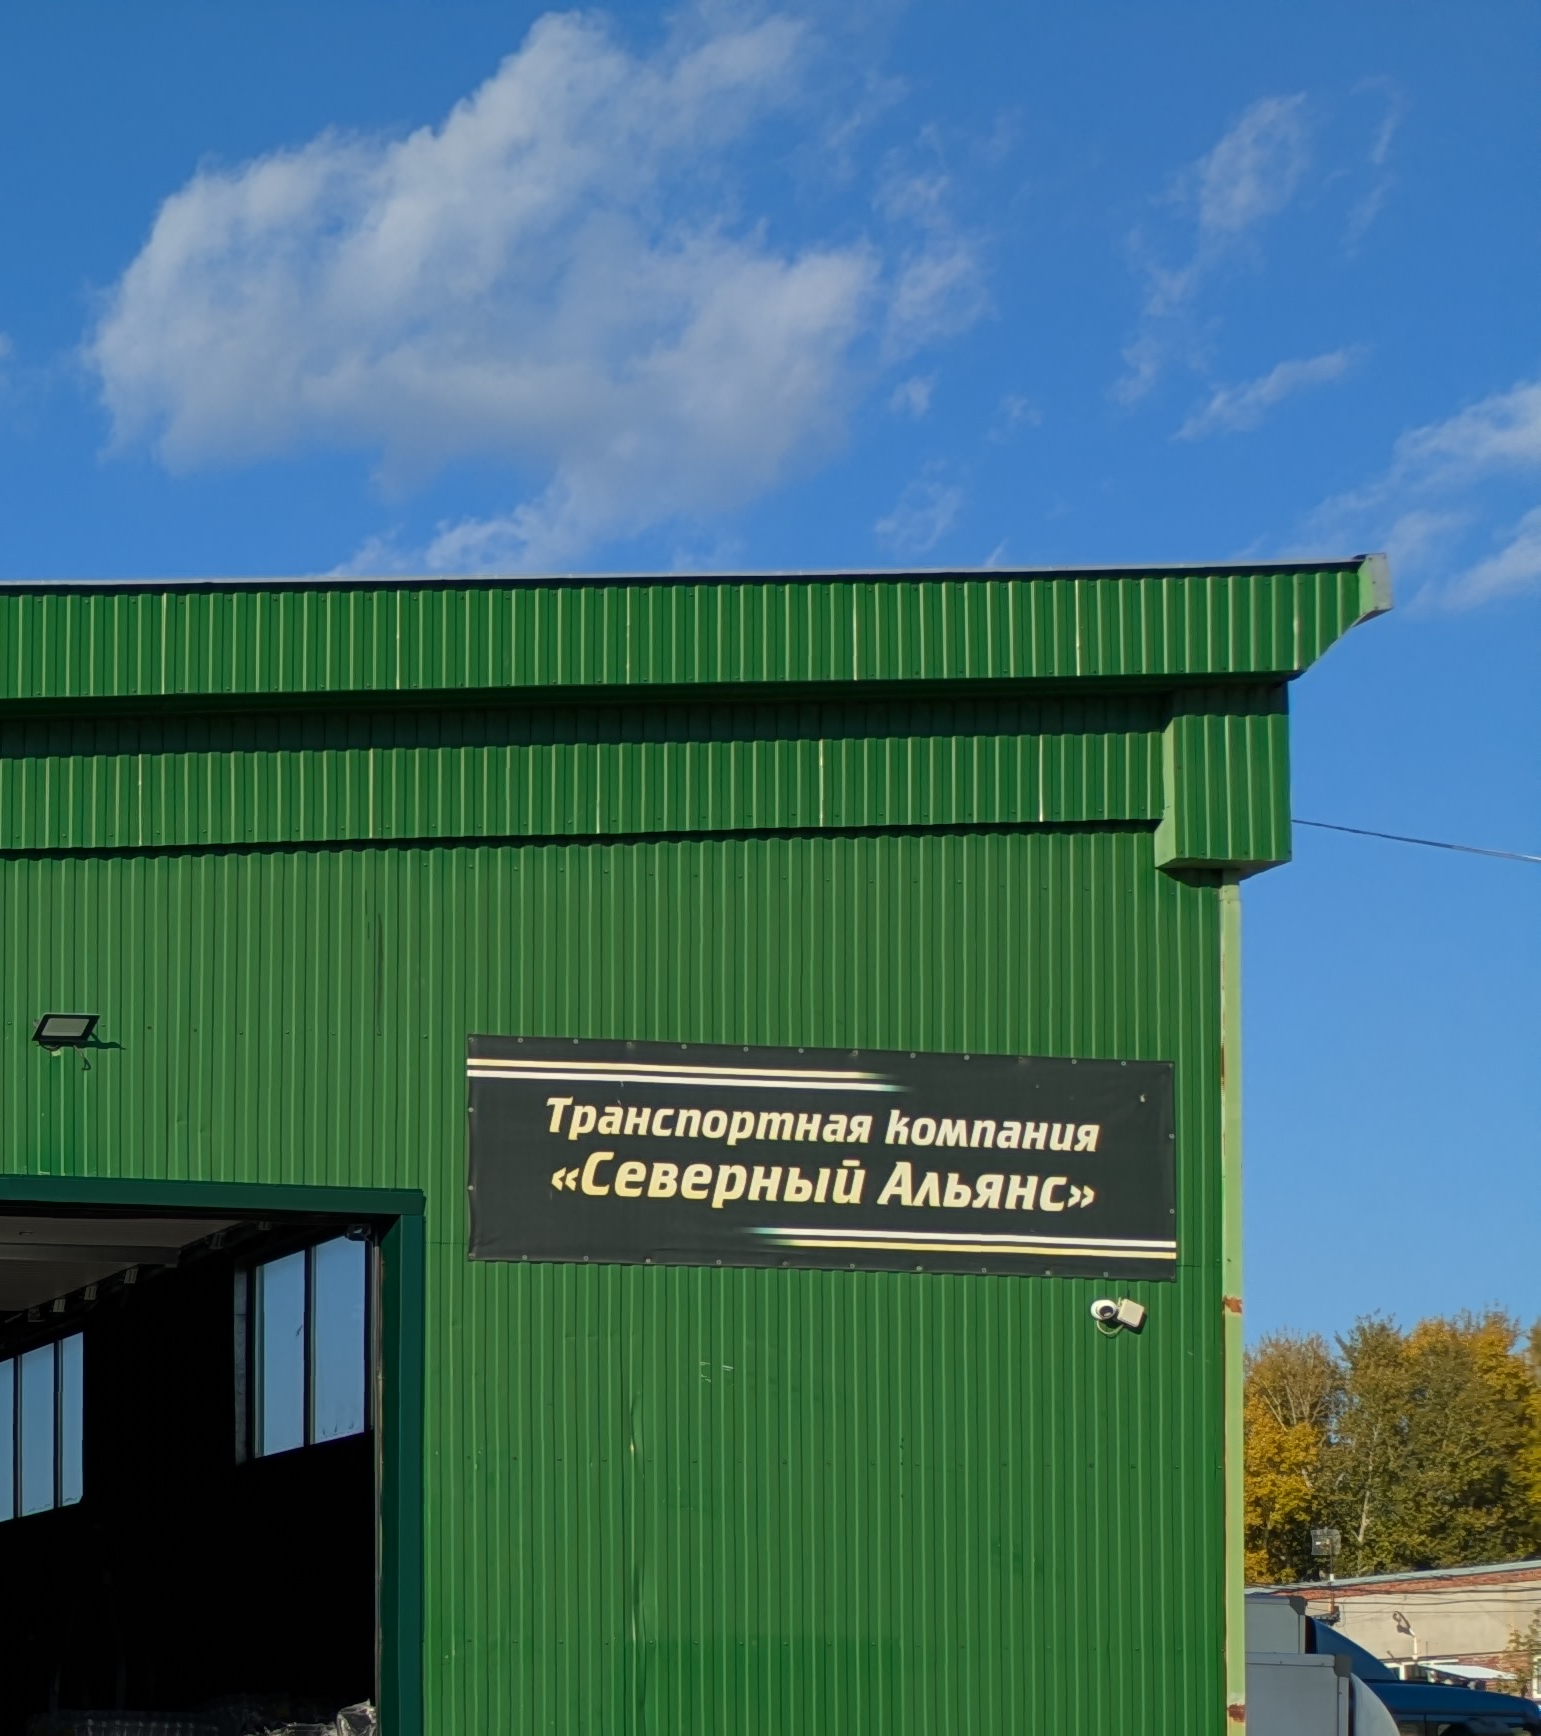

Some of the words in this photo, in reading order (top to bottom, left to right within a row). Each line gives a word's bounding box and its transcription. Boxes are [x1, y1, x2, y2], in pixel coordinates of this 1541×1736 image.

[546, 1096, 870, 1147] Транспортная
[884, 1109, 1101, 1152] компания
[550, 1151, 863, 1209] «Северный
[876, 1162, 1096, 1212] Альянс»
